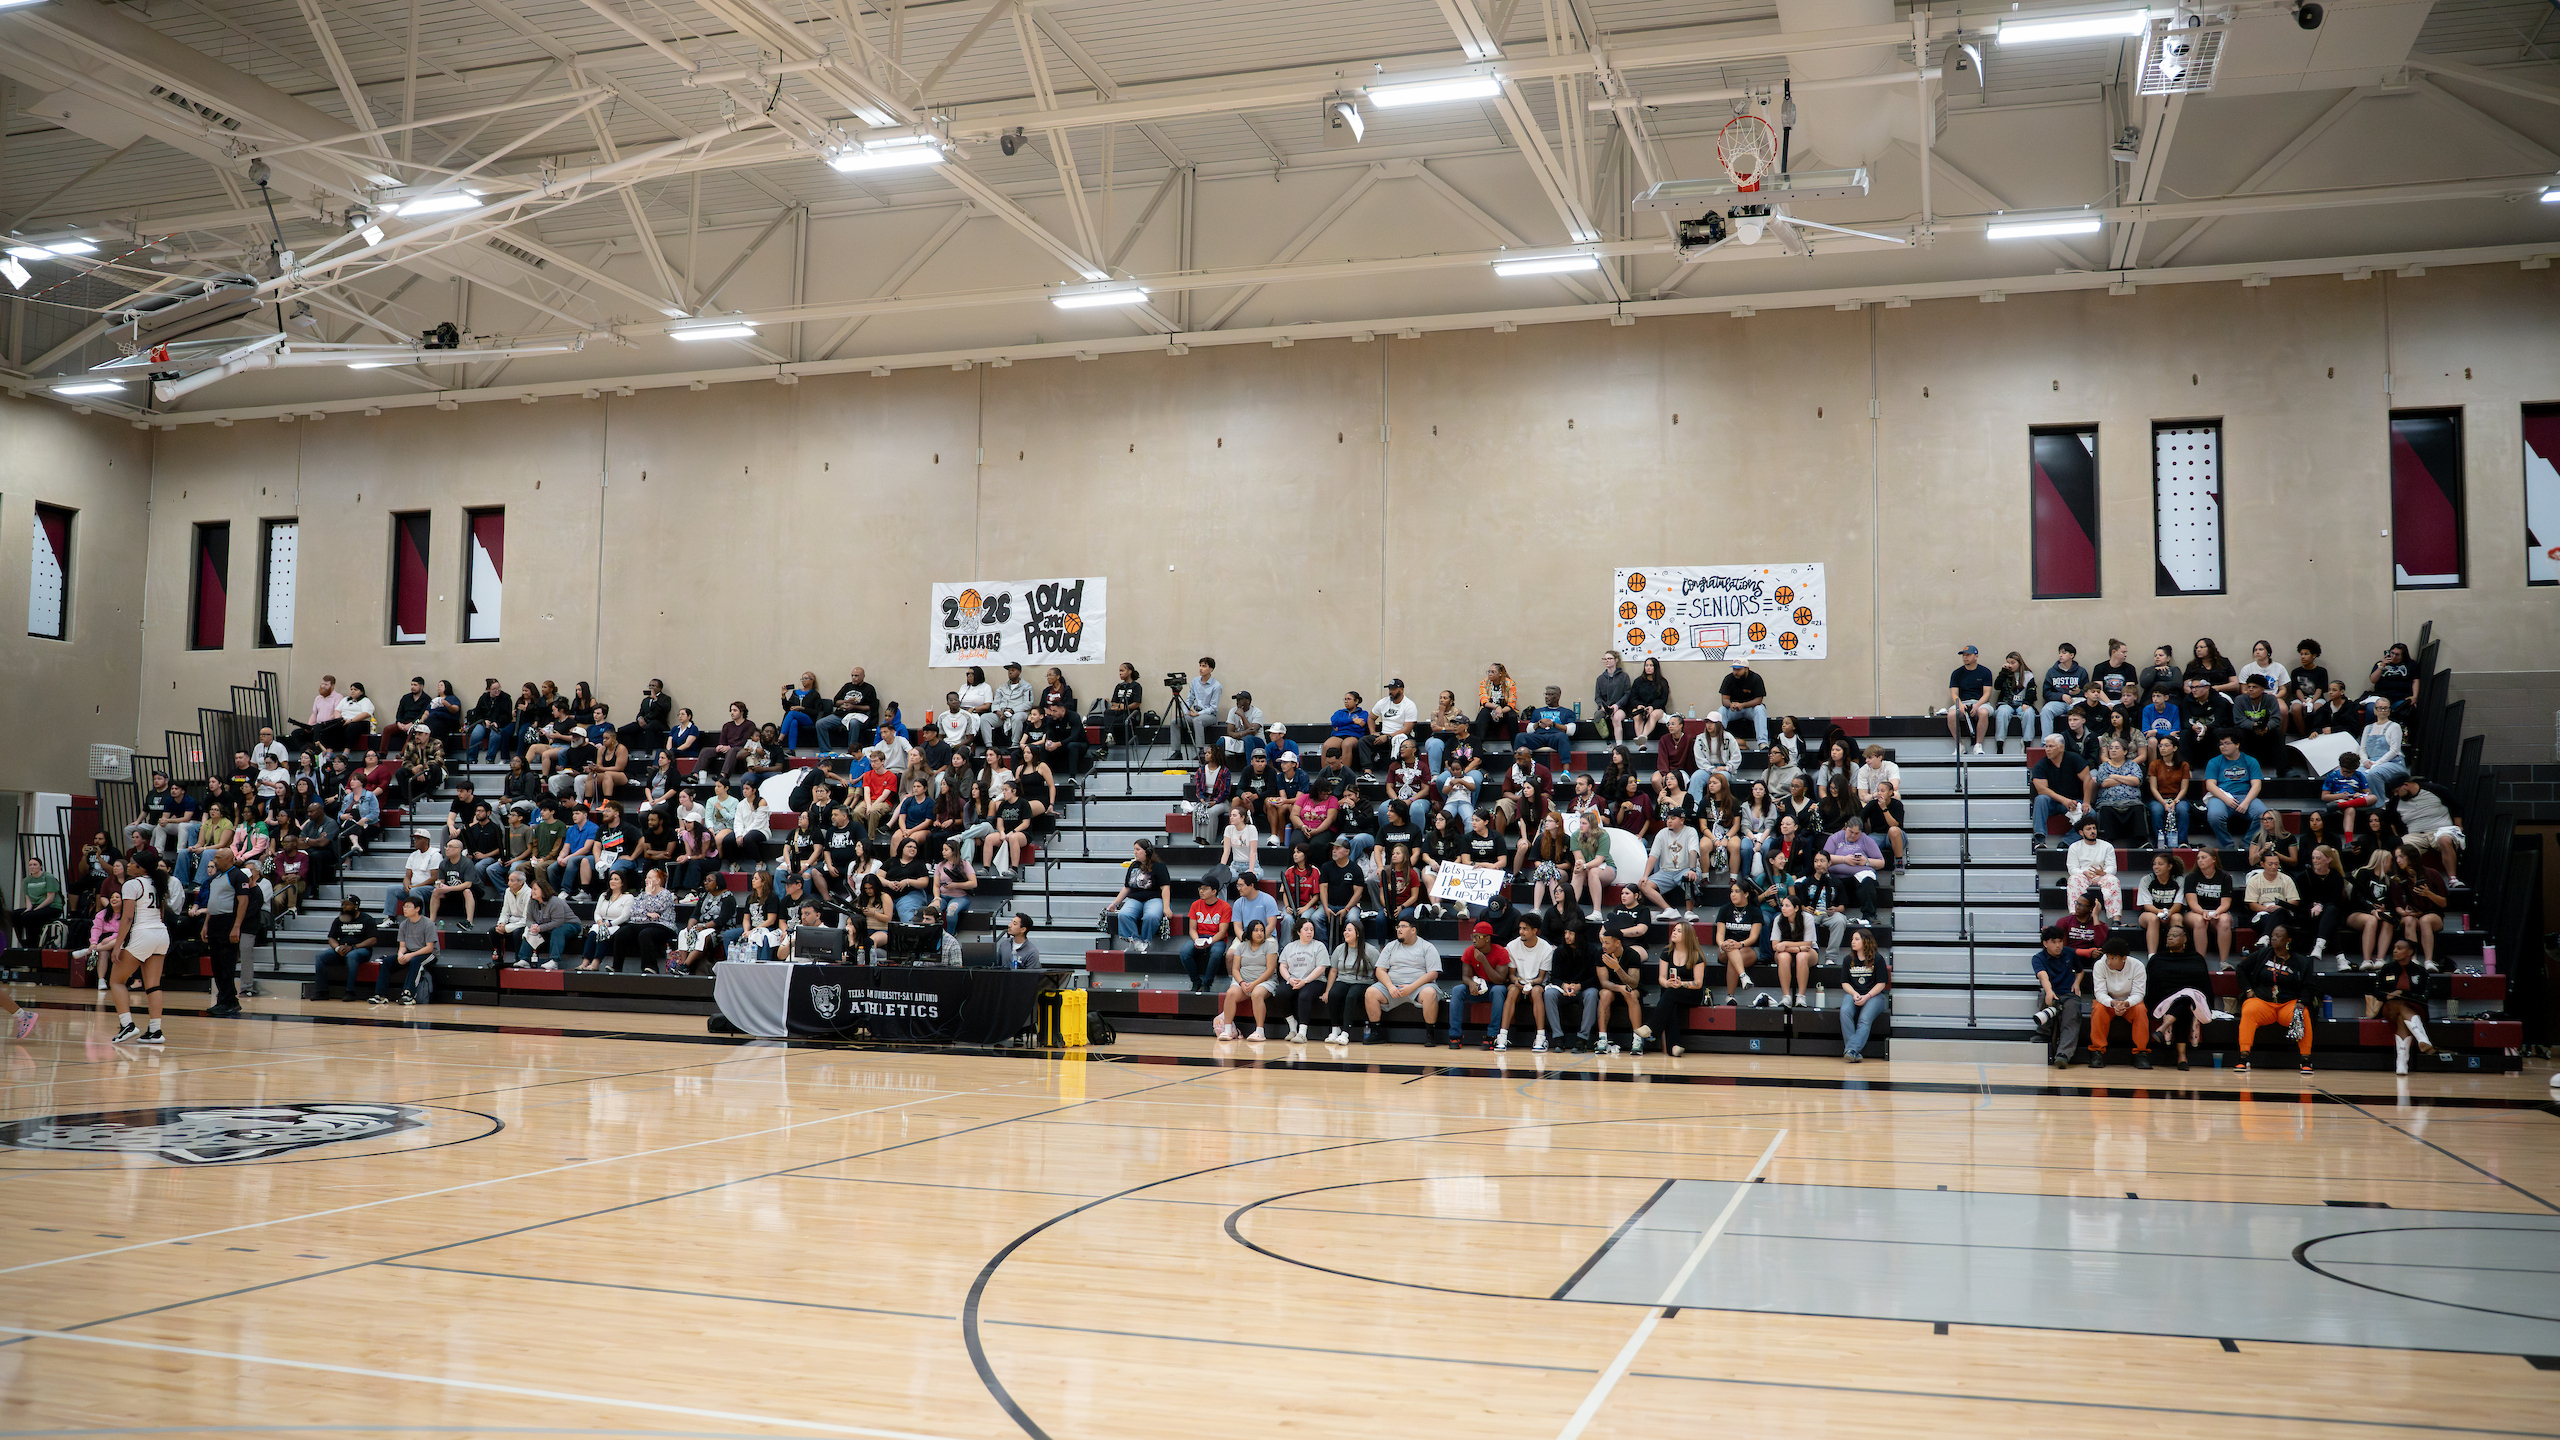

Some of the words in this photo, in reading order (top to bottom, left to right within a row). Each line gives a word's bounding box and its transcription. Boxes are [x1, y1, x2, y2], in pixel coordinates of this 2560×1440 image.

[1024, 579, 1085, 622] Loud
[1688, 595, 1760, 619] SENIORS
[1777, 604, 1790, 612] #5
[1043, 613, 1064, 629] and
[945, 632, 1001, 654] JAGUARS
[1023, 621, 1084, 655] Proud
[2052, 677, 2079, 687] BOSTON
[848, 989, 865, 998] TEXAS
[915, 992, 938, 1003] ANTONIO
[850, 1001, 938, 1018] ATHLETICS
